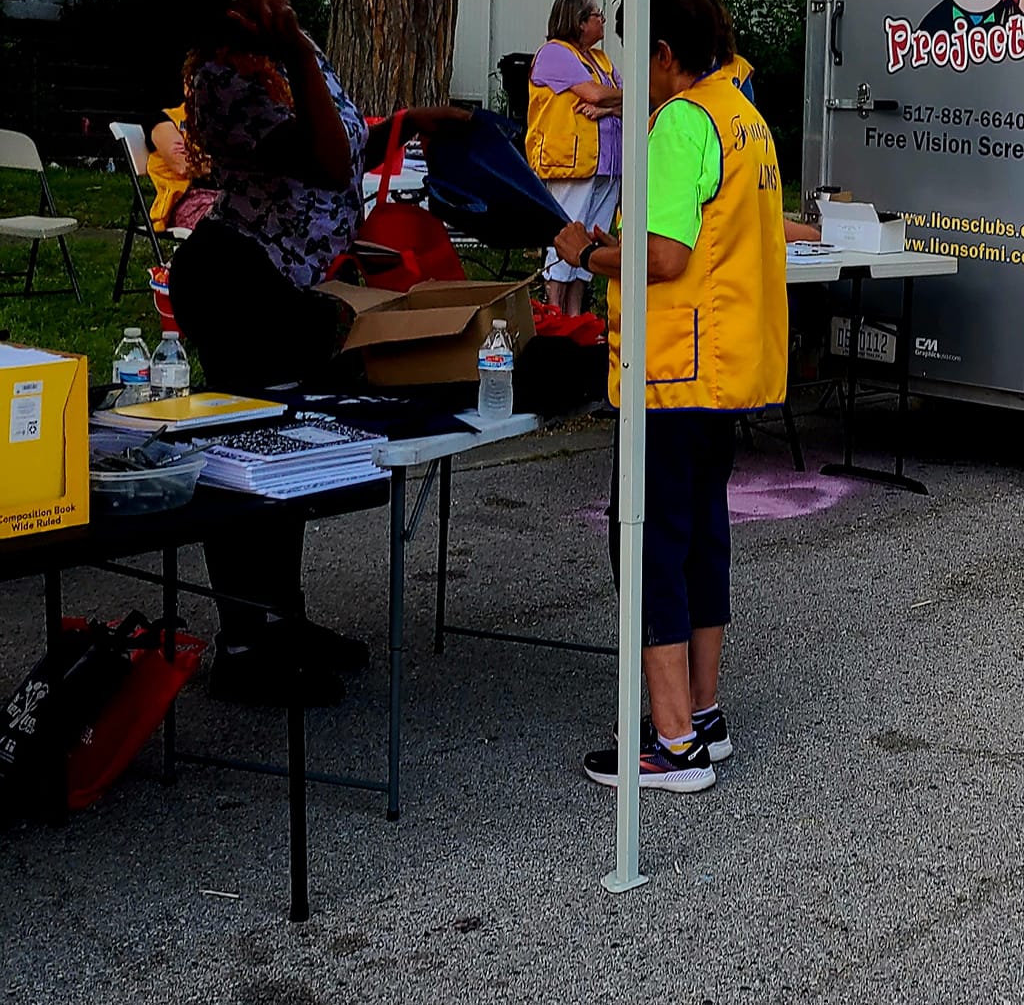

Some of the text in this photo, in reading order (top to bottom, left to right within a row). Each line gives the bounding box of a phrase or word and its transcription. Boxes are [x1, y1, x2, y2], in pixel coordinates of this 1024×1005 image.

[865, 127, 907, 149] Free
[913, 130, 972, 155] Vision
[0, 503, 76, 523] Composition Book
[11, 515, 61, 532] Wide Ruled
